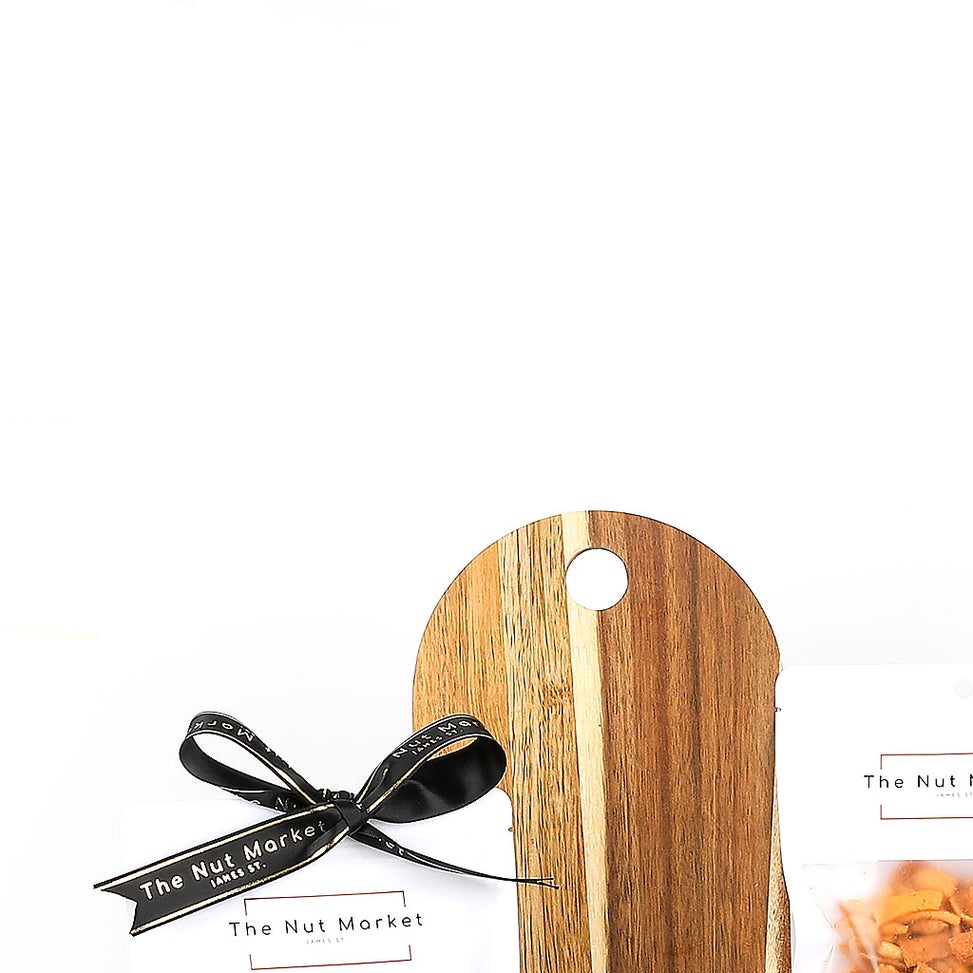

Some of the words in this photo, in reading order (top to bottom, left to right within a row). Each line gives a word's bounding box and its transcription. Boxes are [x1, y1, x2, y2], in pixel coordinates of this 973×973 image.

[392, 733, 432, 758] Nut
[863, 774, 905, 789] The
[917, 774, 956, 788] Nut
[139, 875, 185, 900] The
[191, 853, 235, 881] Nut
[243, 820, 327, 861] Market
[210, 867, 245, 888] JAMES
[228, 921, 272, 937] The
[285, 919, 326, 934] Nut
[338, 913, 424, 932] Market
